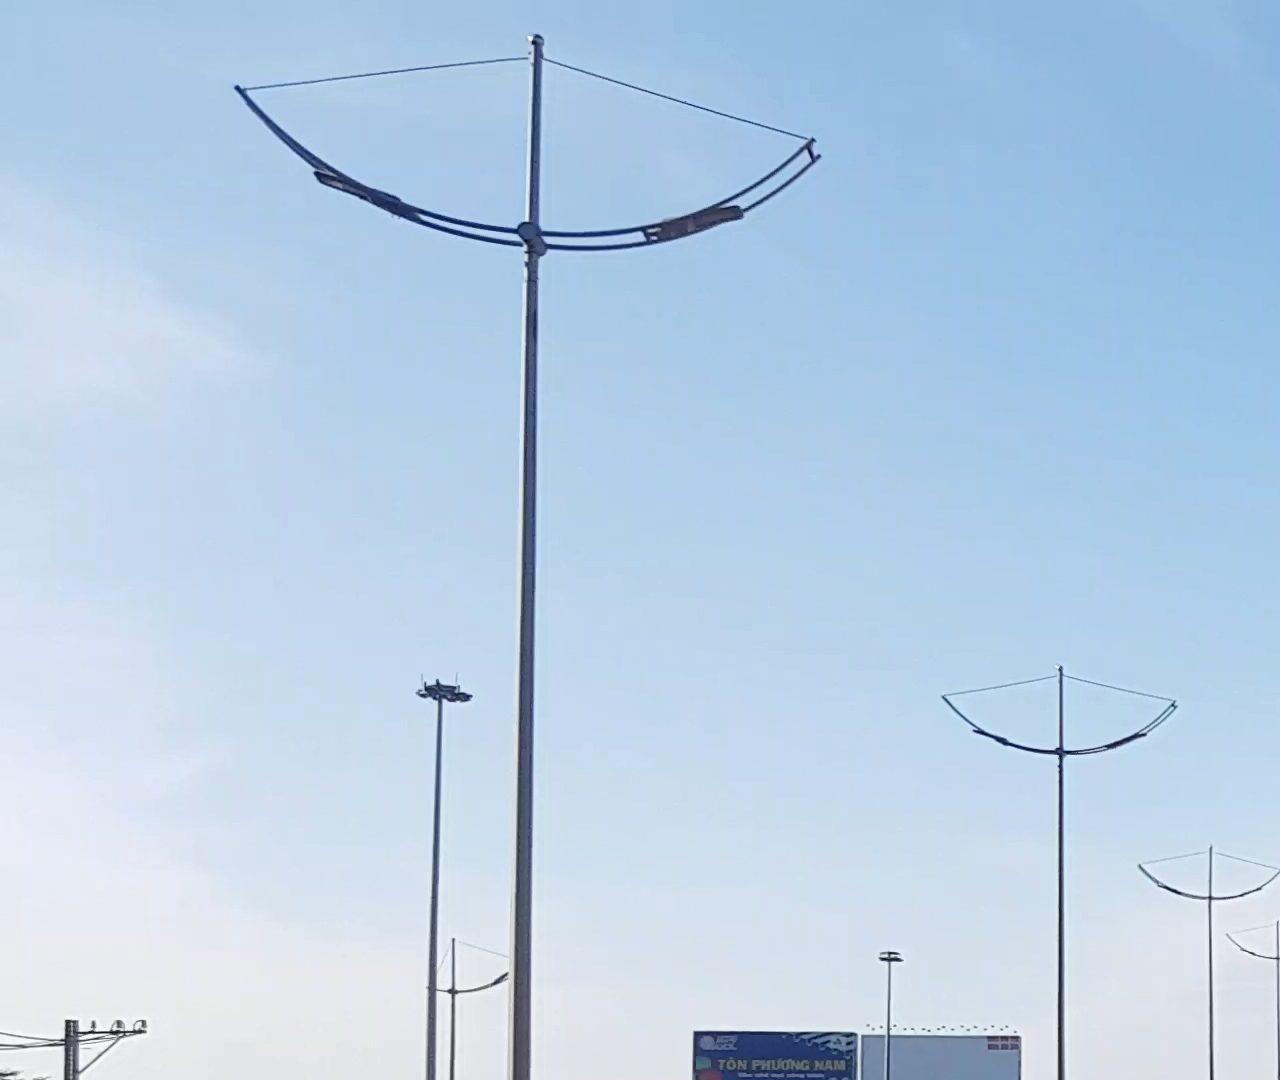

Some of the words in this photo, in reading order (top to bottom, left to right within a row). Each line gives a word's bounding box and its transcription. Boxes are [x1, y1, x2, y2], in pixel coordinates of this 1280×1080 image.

[718, 1057, 747, 1071] TÔN
[752, 1058, 810, 1071] PHƯƠNG
[813, 1060, 846, 1071] NAM
